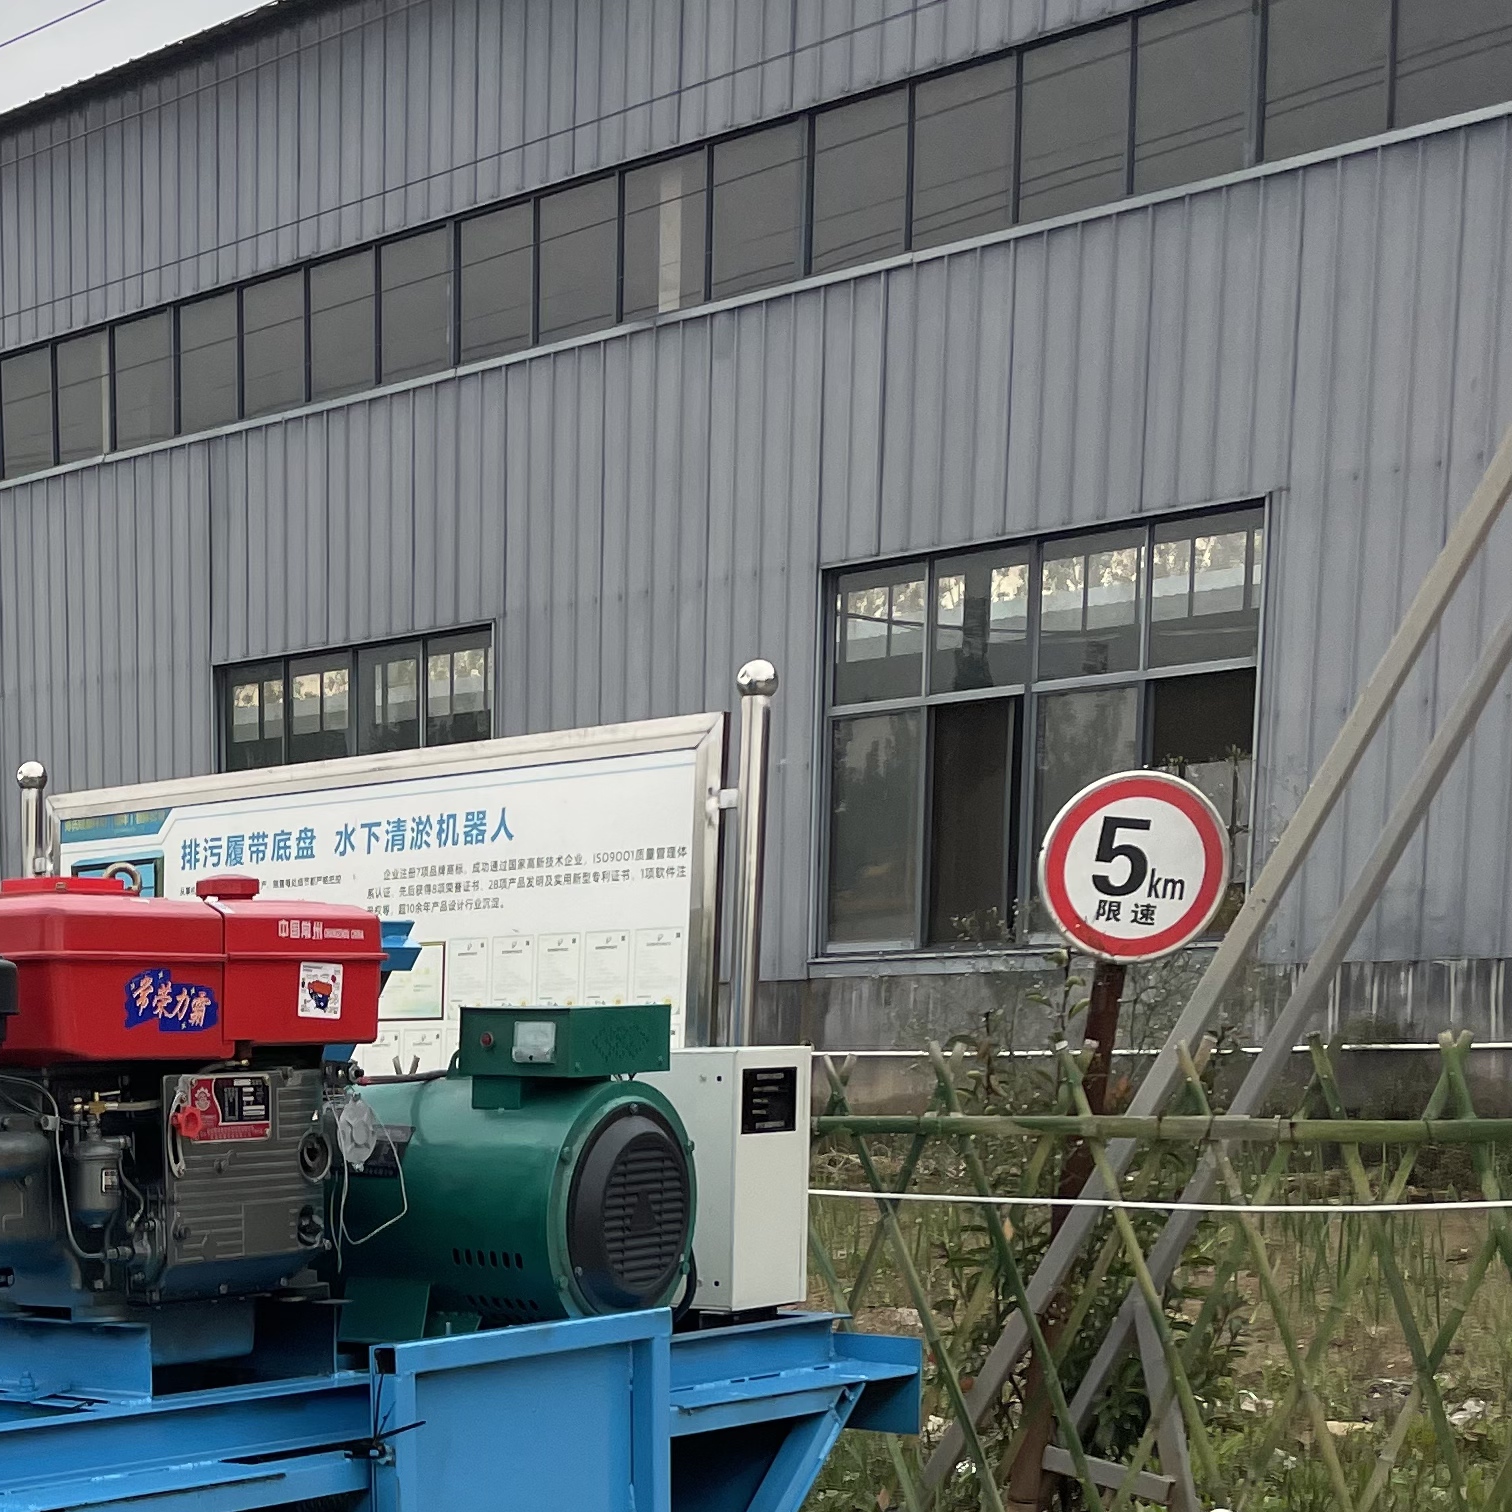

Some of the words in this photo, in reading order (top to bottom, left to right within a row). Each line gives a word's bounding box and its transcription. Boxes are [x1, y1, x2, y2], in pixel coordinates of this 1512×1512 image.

[180, 826, 317, 871] 排污履带底盘
[335, 806, 515, 857] 水下清淤机器人
[1095, 899, 1157, 925] 限速
